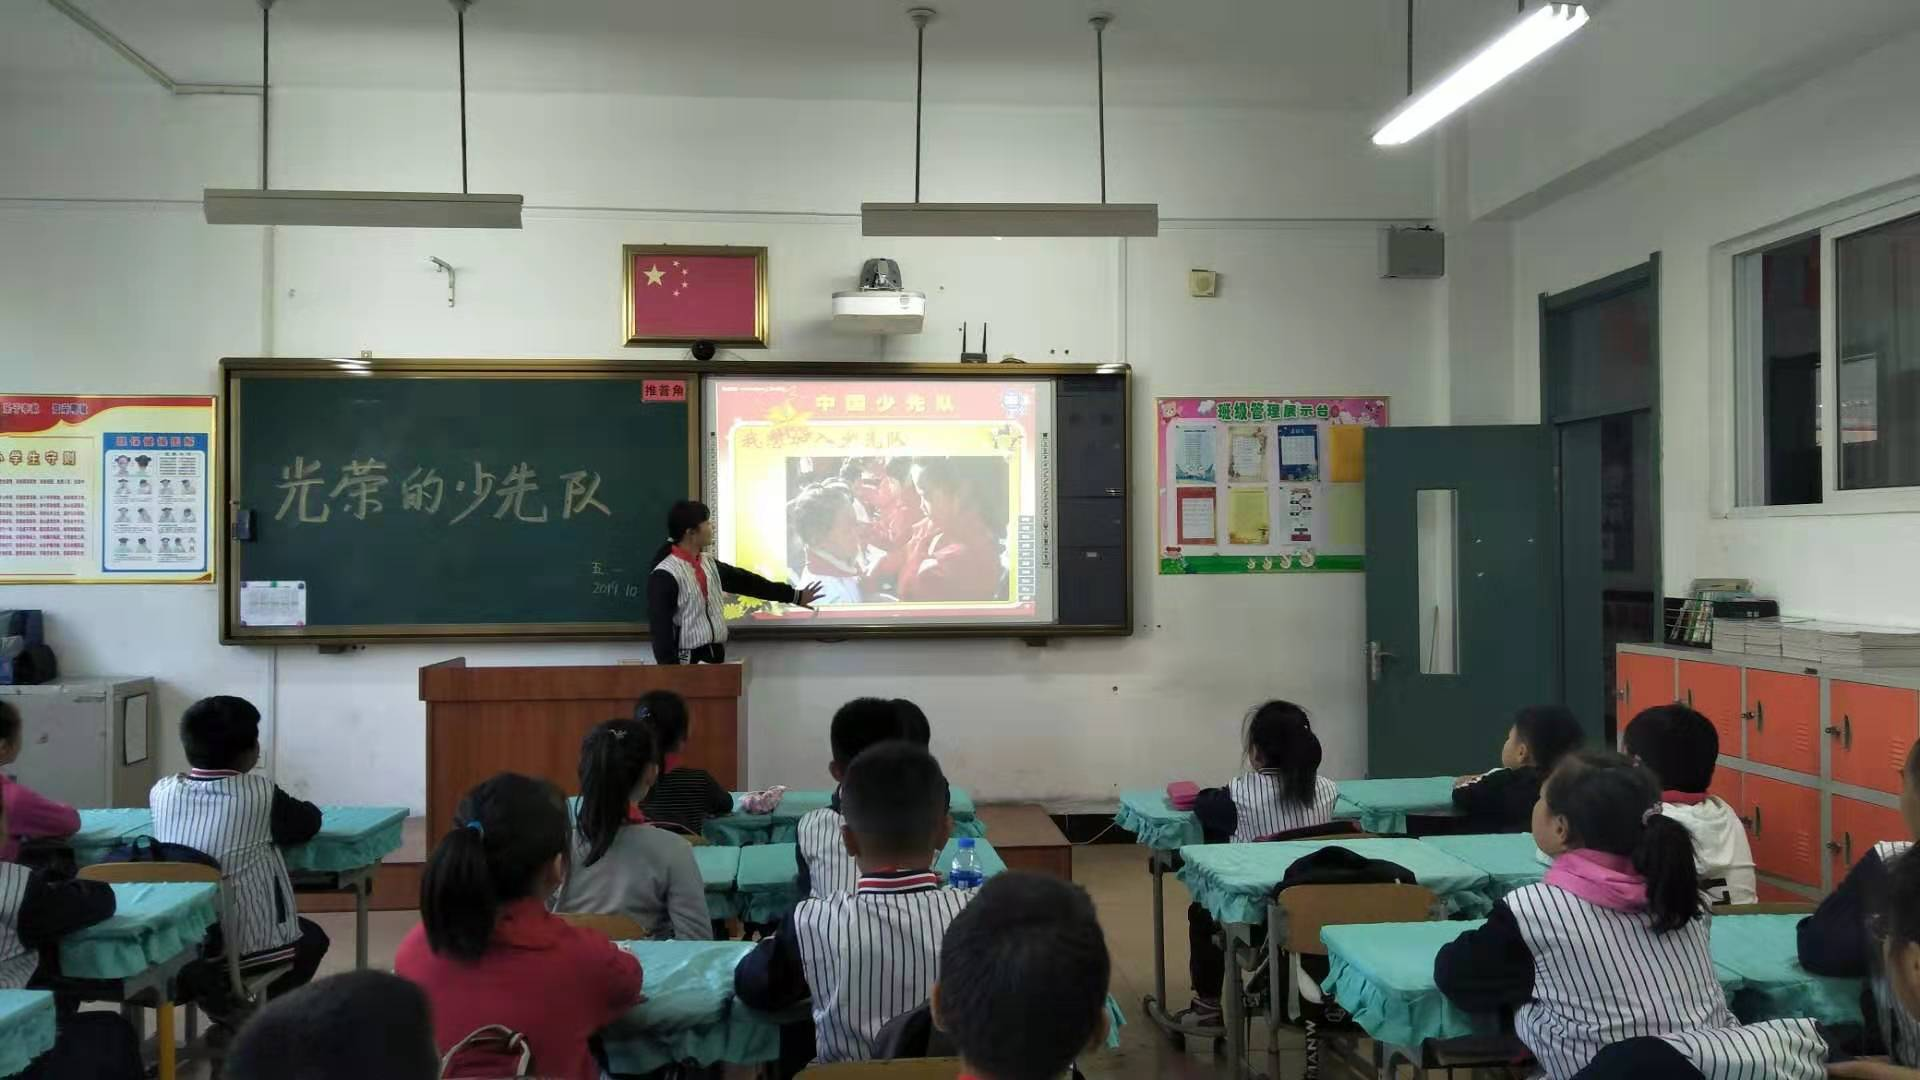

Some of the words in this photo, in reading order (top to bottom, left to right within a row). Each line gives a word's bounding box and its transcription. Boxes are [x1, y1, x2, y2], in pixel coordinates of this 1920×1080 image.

[1217, 401, 1329, 421] 班级管理展示台
[0, 450, 76, 466] 学生守则
[274, 455, 612, 526] 光荣的少先队
